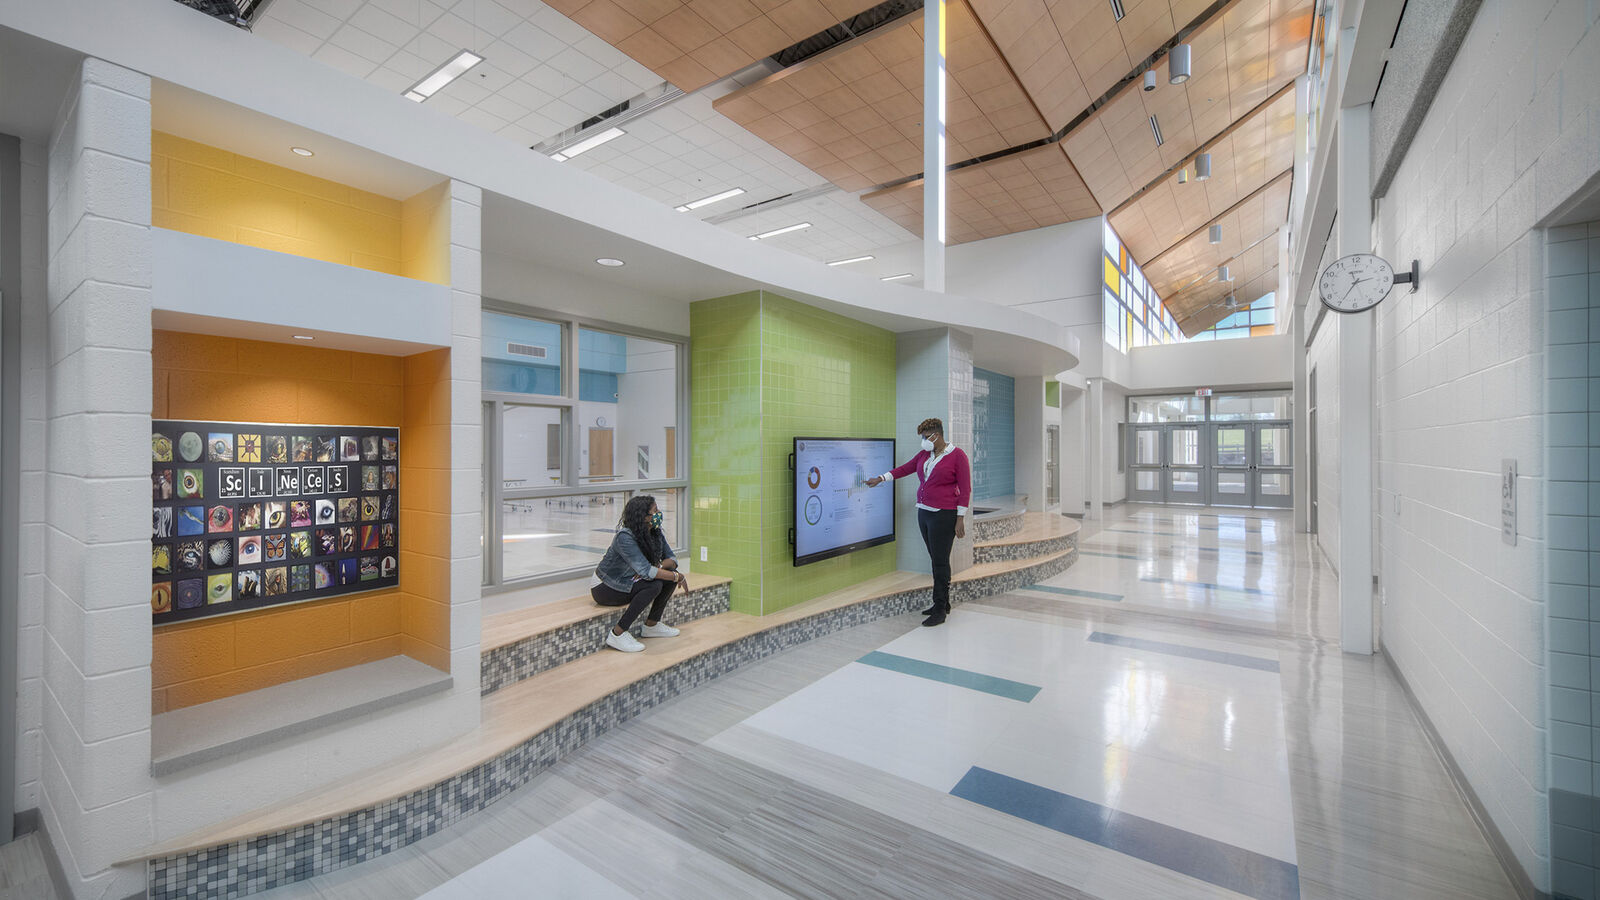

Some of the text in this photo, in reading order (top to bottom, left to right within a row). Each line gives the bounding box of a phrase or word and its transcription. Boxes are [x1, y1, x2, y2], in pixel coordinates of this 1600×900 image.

[226, 472, 341, 491] Sc I Ne Ce S
